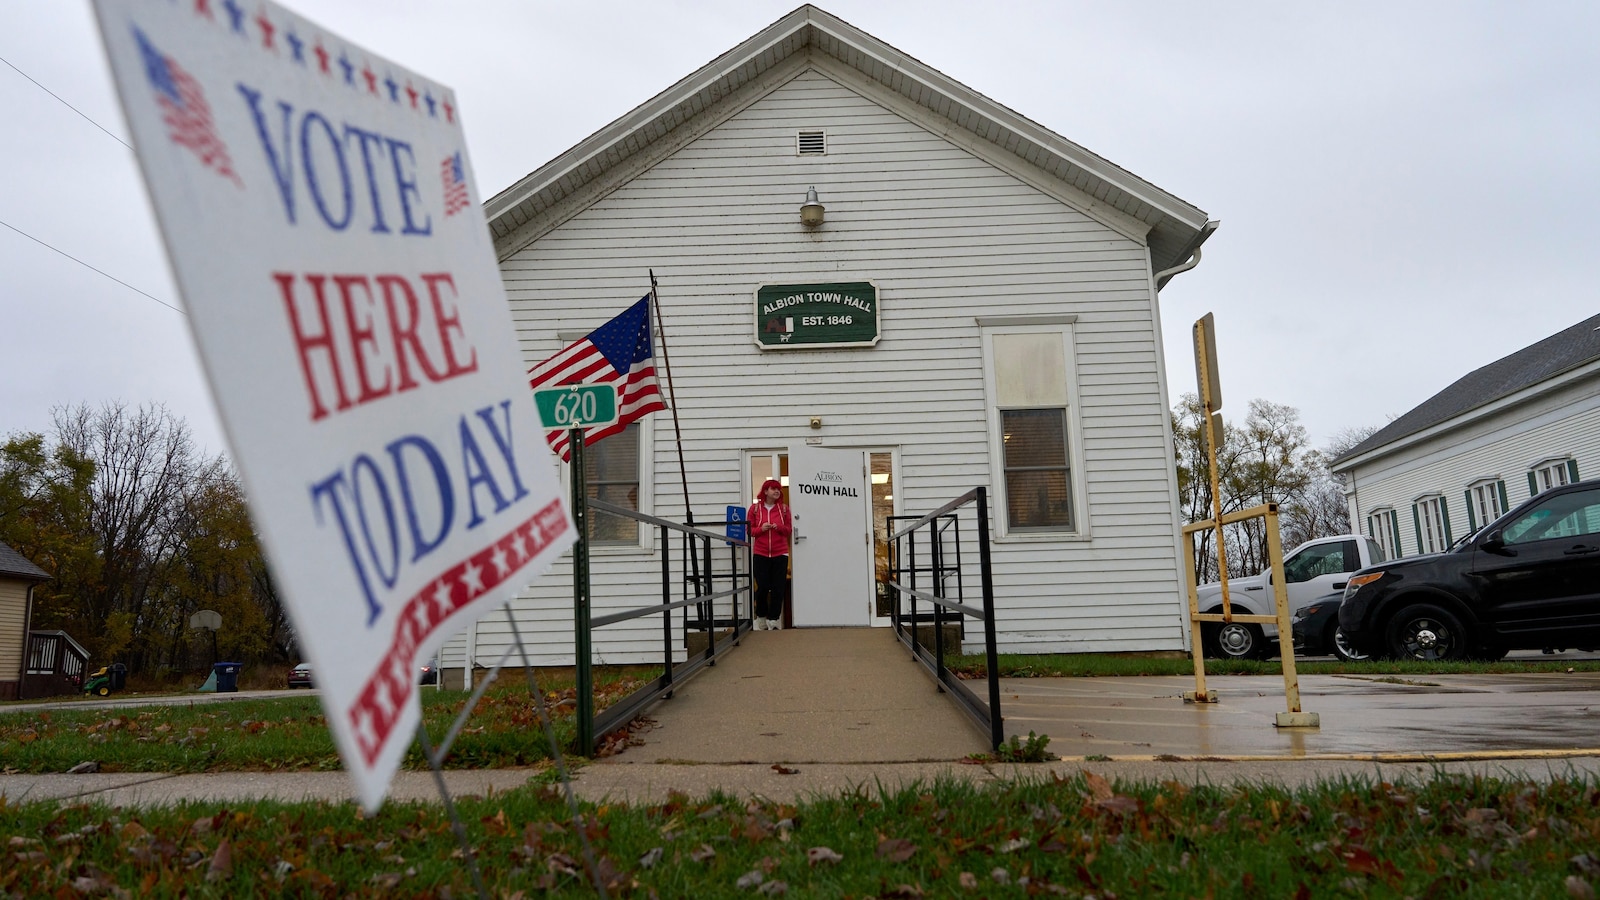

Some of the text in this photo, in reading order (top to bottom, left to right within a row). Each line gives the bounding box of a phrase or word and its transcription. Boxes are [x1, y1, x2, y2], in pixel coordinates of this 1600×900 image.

[237, 83, 432, 236] VOTE
[763, 292, 871, 315] ALBION TOWN HALL
[802, 315, 852, 326] EST. 1846
[271, 273, 479, 421] HERE
[554, 390, 597, 424] 620
[798, 483, 858, 498] TOWN HALL
[309, 400, 530, 628] TODAY
